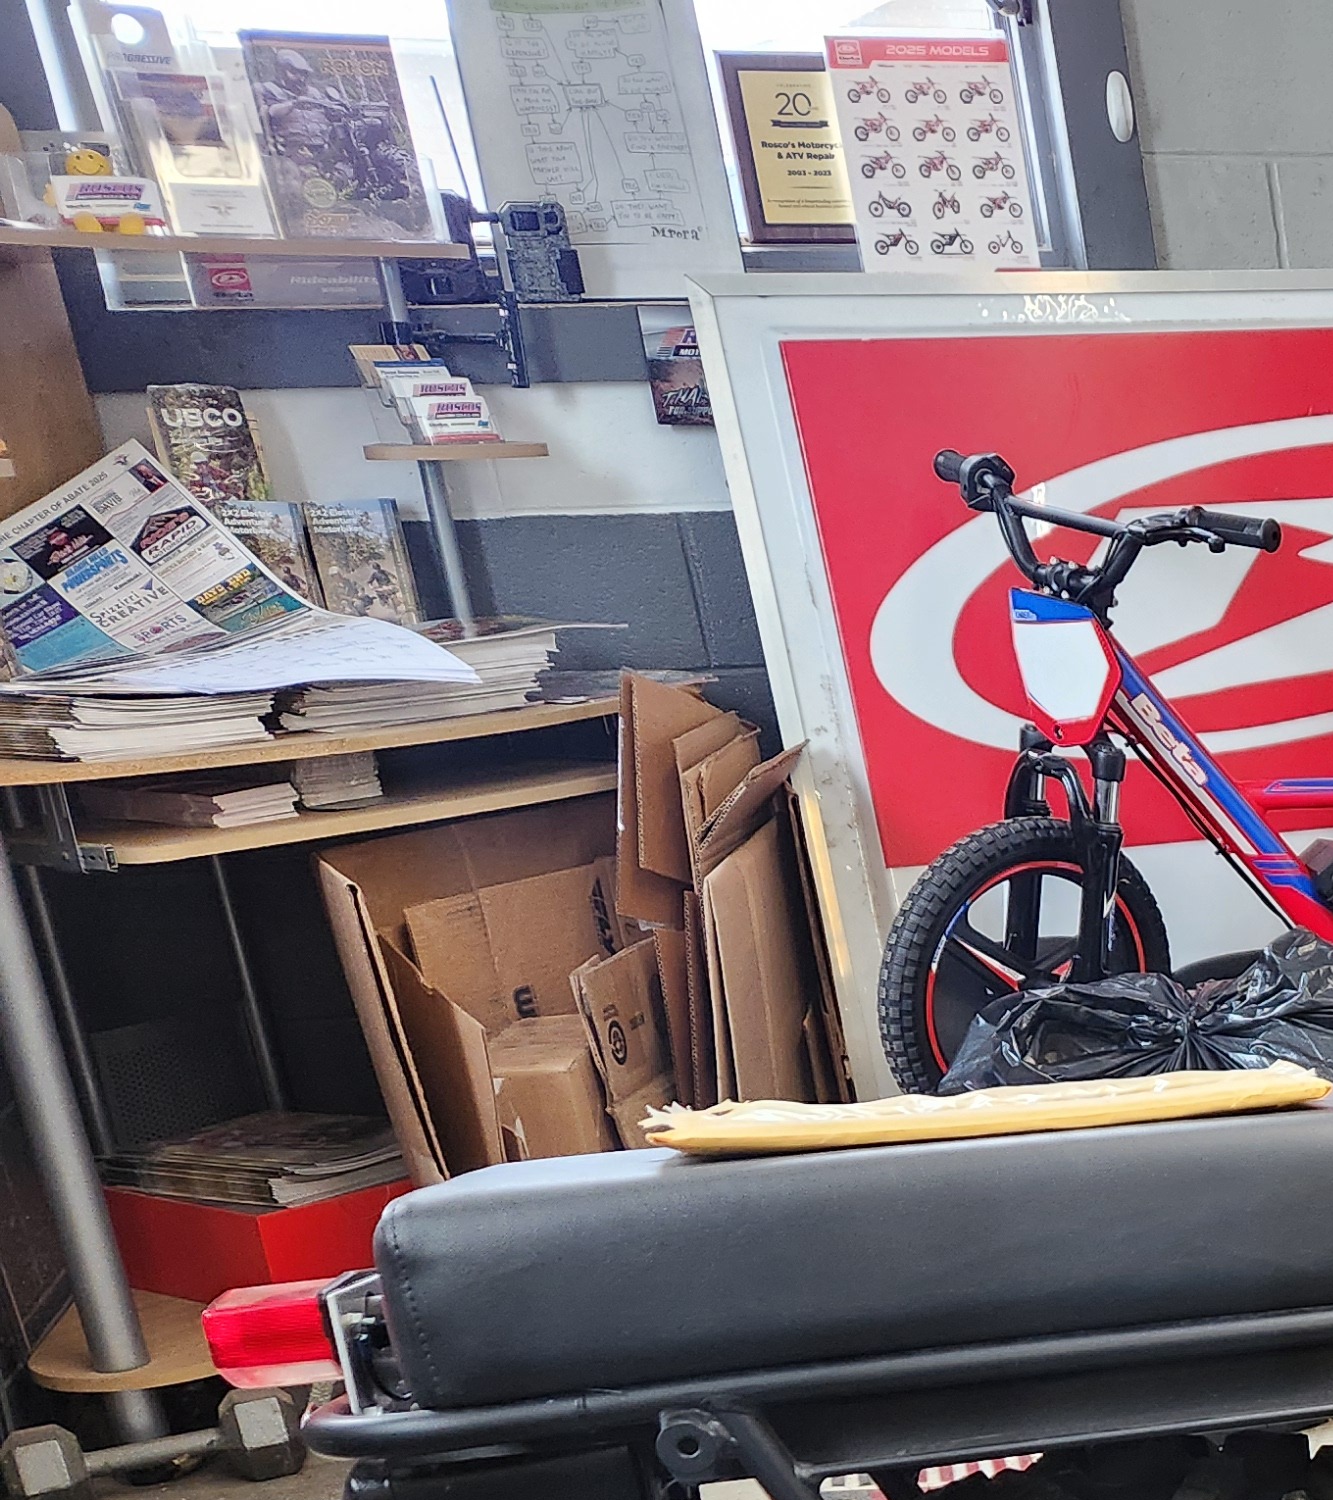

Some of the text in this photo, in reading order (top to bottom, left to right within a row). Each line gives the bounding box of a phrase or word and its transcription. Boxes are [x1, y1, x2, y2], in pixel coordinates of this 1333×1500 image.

[886, 45, 990, 57] 2025 MODELS
[775, 92, 812, 116] 20
[761, 141, 843, 151] Rosco's Motorcyc
[806, 152, 835, 161] Repair
[161, 408, 243, 427] UBCO
[12, 506, 52, 539] CHAPTER
[50, 500, 65, 514] OF
[147, 519, 198, 555] RAPID
[99, 586, 171, 629] CREATIVE
[1130, 693, 1208, 787] Beta
